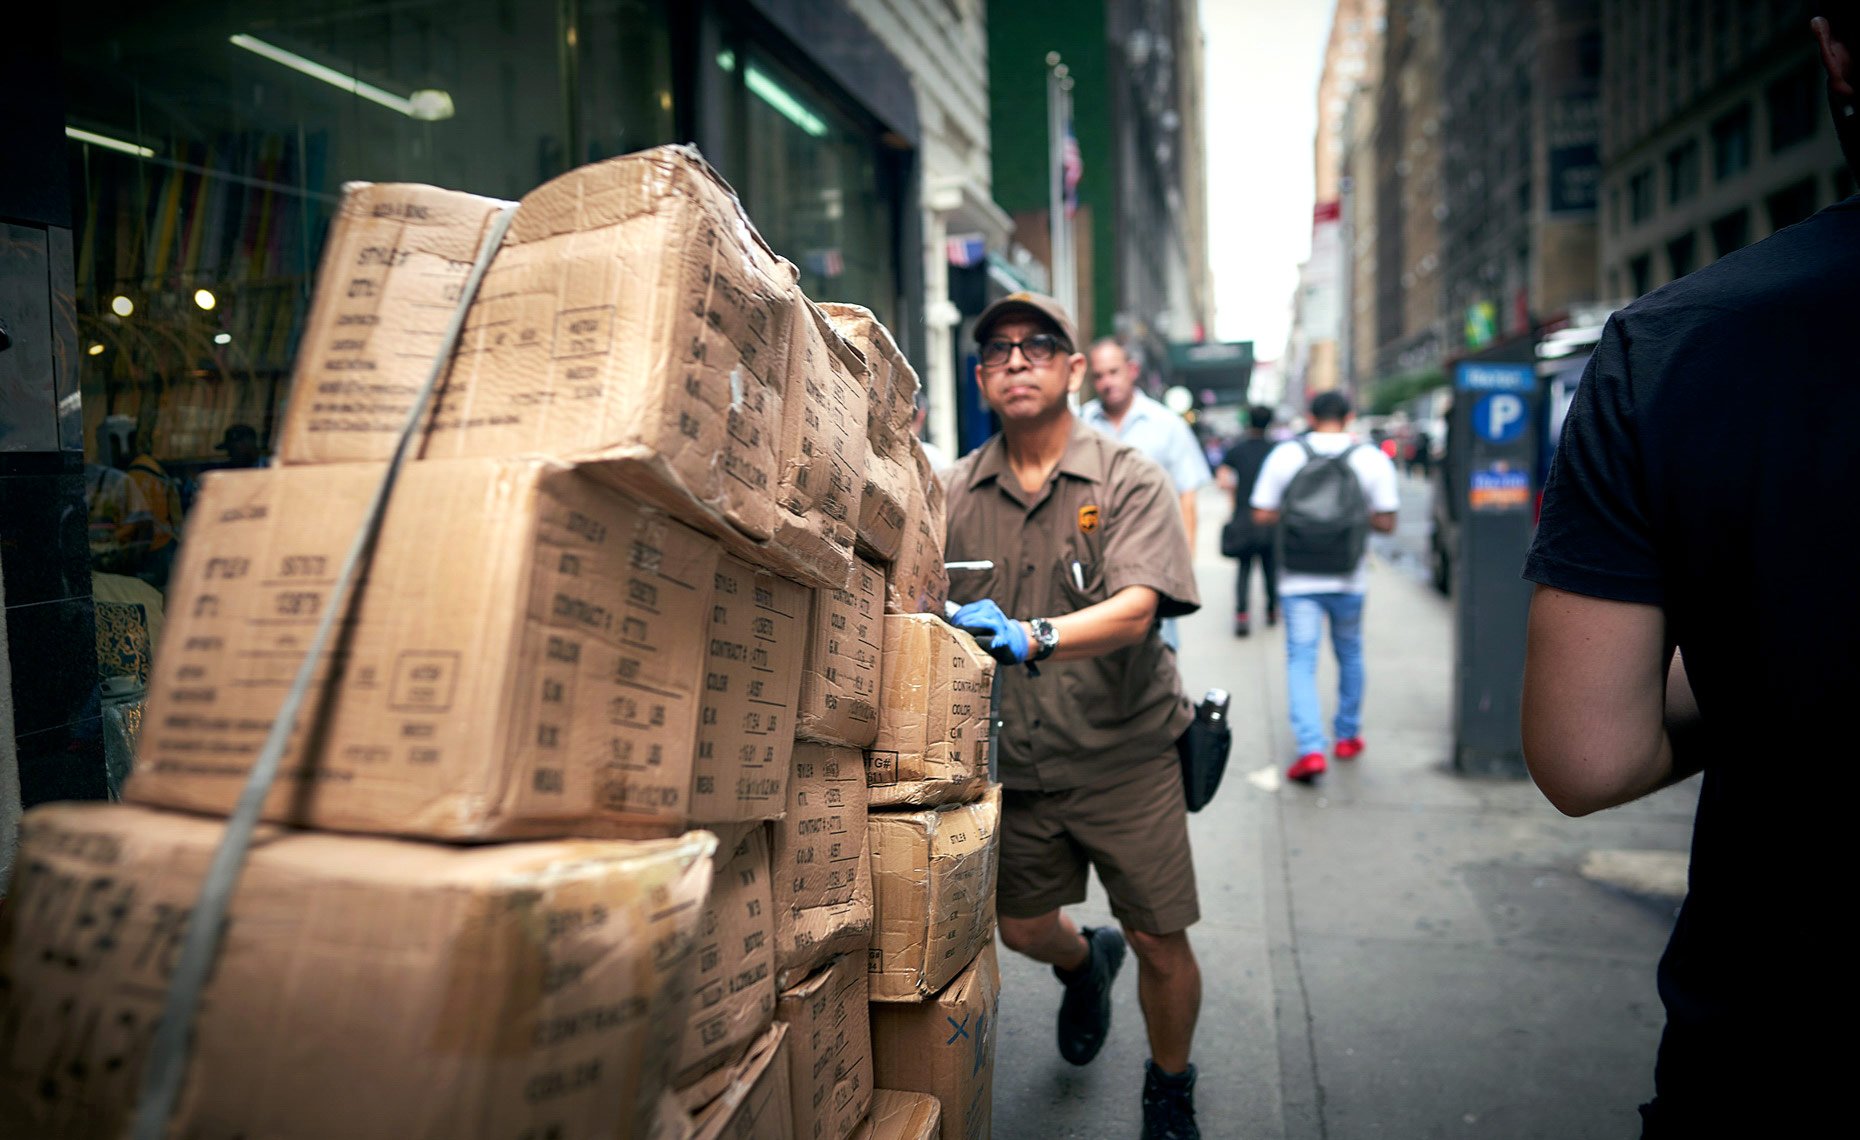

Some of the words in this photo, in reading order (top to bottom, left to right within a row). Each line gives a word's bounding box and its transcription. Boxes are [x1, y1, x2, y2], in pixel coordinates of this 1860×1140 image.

[1489, 393, 1523, 439] P
[709, 638, 743, 662] CONTRACT
[706, 672, 728, 694] COLOR
[952, 703, 971, 716] COLOR
[864, 757, 891, 769] TG#
[798, 817, 822, 836] CONTRACT
